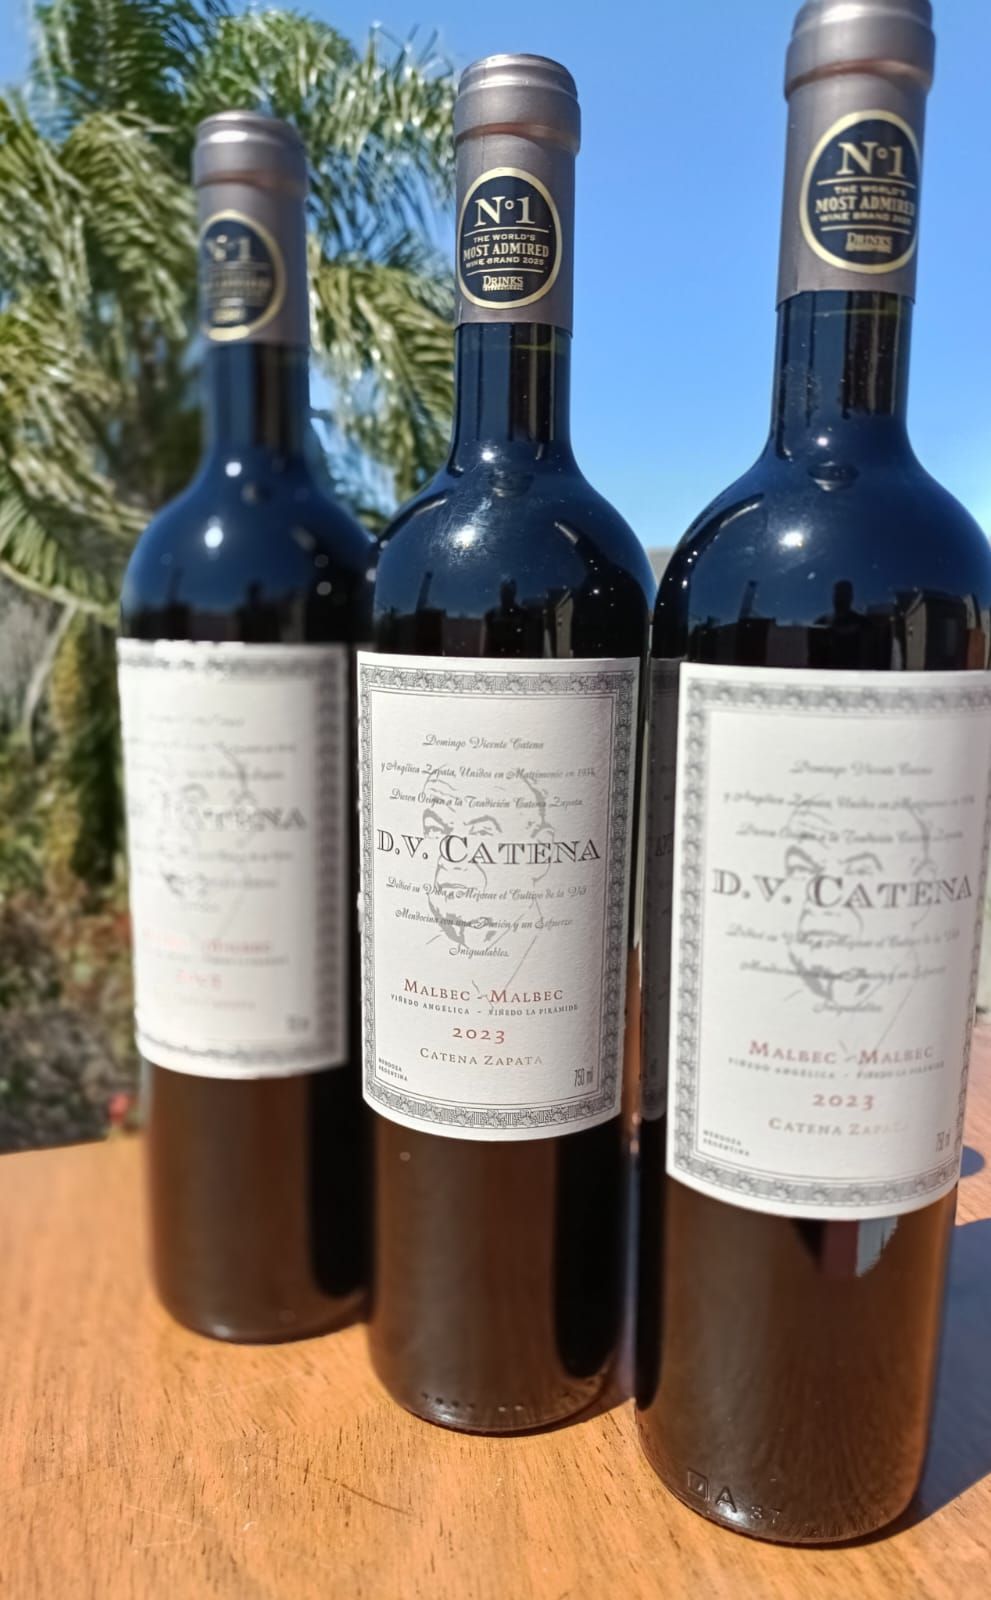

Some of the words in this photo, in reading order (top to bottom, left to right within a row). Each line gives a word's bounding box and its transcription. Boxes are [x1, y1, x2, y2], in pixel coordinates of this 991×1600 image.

[815, 196, 857, 213] MOST
[473, 235, 490, 244] THE
[492, 233, 536, 241] WORLD'S
[463, 244, 490, 260] MOST
[492, 242, 549, 258] ADMIRED
[486, 256, 520, 265] BRAND
[482, 275, 524, 287] DRINKS
[422, 733, 467, 751] Domingo
[469, 736, 508, 749] Vicente
[509, 737, 544, 750] Catena
[376, 829, 429, 860] D.V.
[439, 834, 601, 865] CATENA
[712, 868, 792, 904] D.V.
[807, 875, 972, 909] CATENA
[404, 978, 470, 1002] MALBEC
[488, 989, 564, 1003] MALBEC
[452, 1027, 505, 1044] 2023
[419, 1047, 478, 1065] CATENA
[483, 1055, 543, 1066] ZAPATA
[748, 1040, 837, 1065] MALBEC
[857, 1046, 934, 1066] MALBEC
[812, 1093, 875, 1111] 2023
[768, 1117, 843, 1136] CATENA
